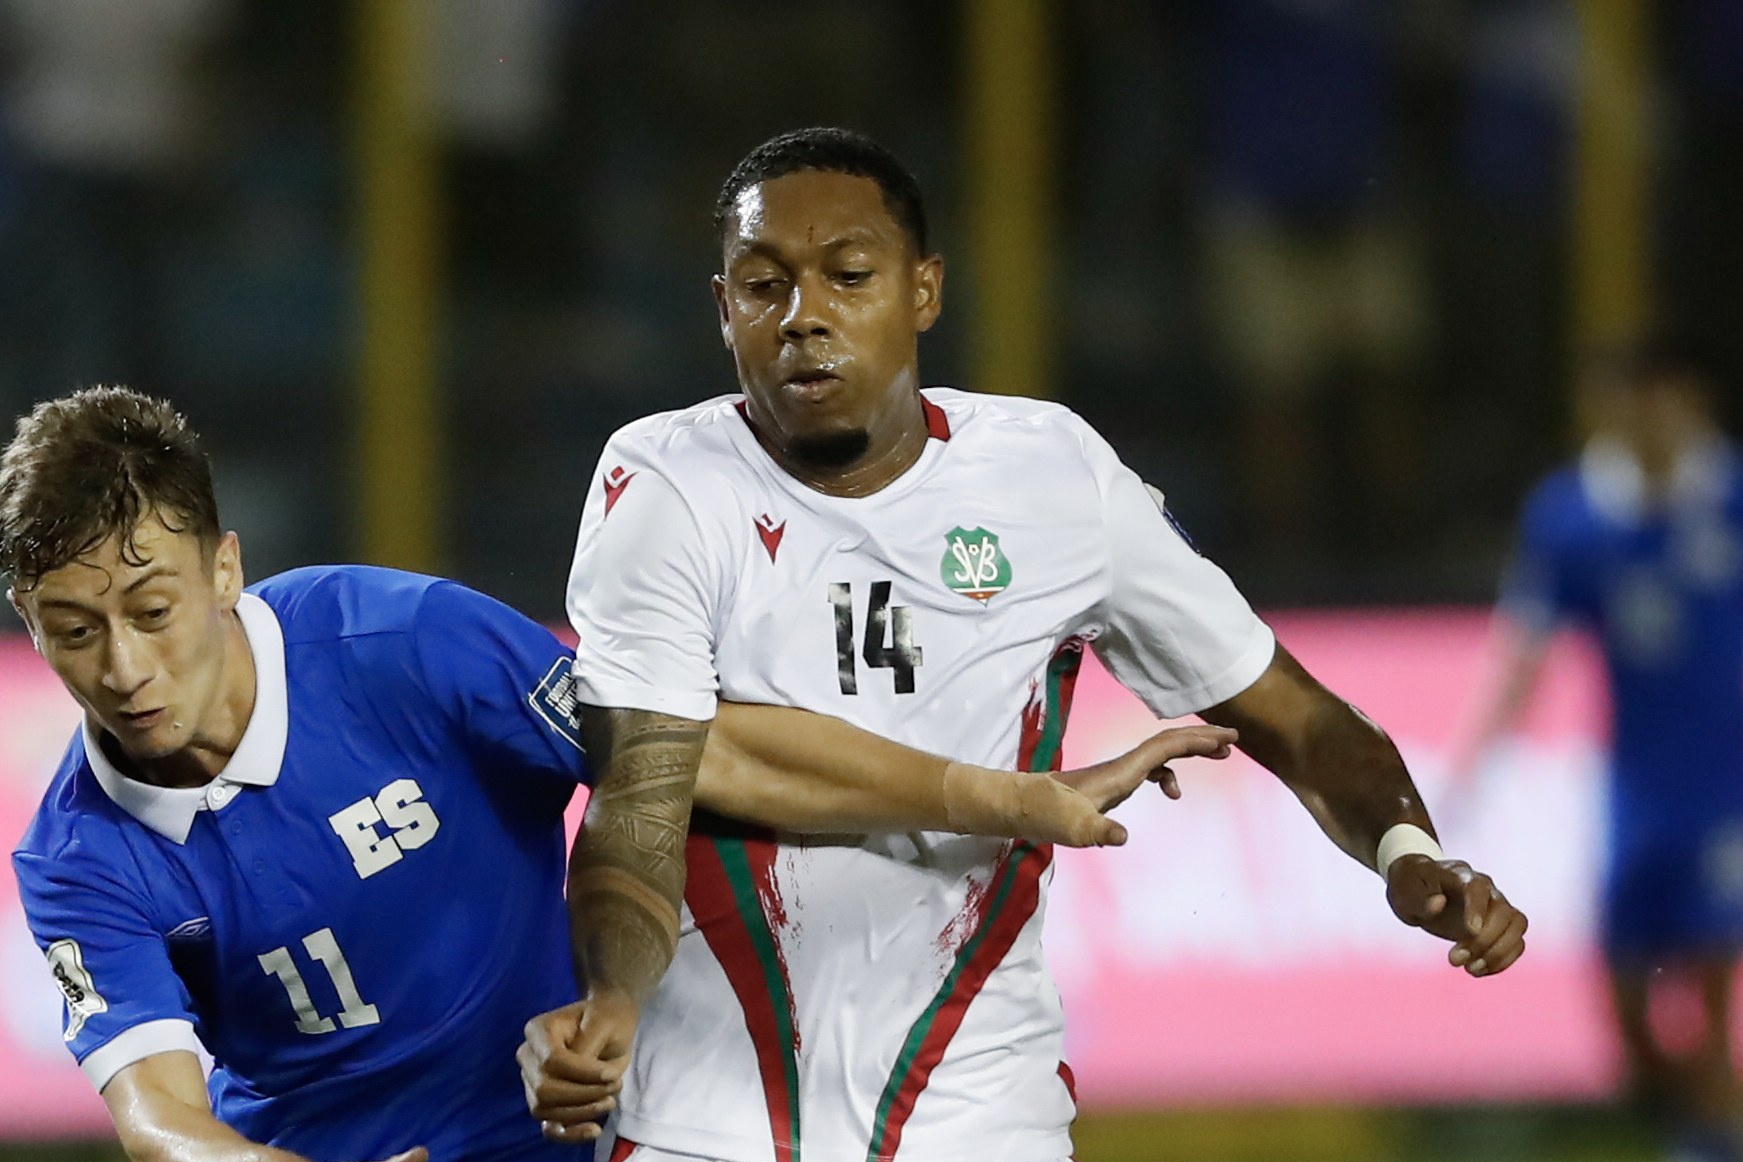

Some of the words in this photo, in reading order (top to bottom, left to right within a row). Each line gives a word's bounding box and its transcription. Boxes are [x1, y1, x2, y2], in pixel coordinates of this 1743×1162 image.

[827, 580, 923, 695] 14
[328, 779, 441, 880] ES
[257, 927, 381, 1034] 11
